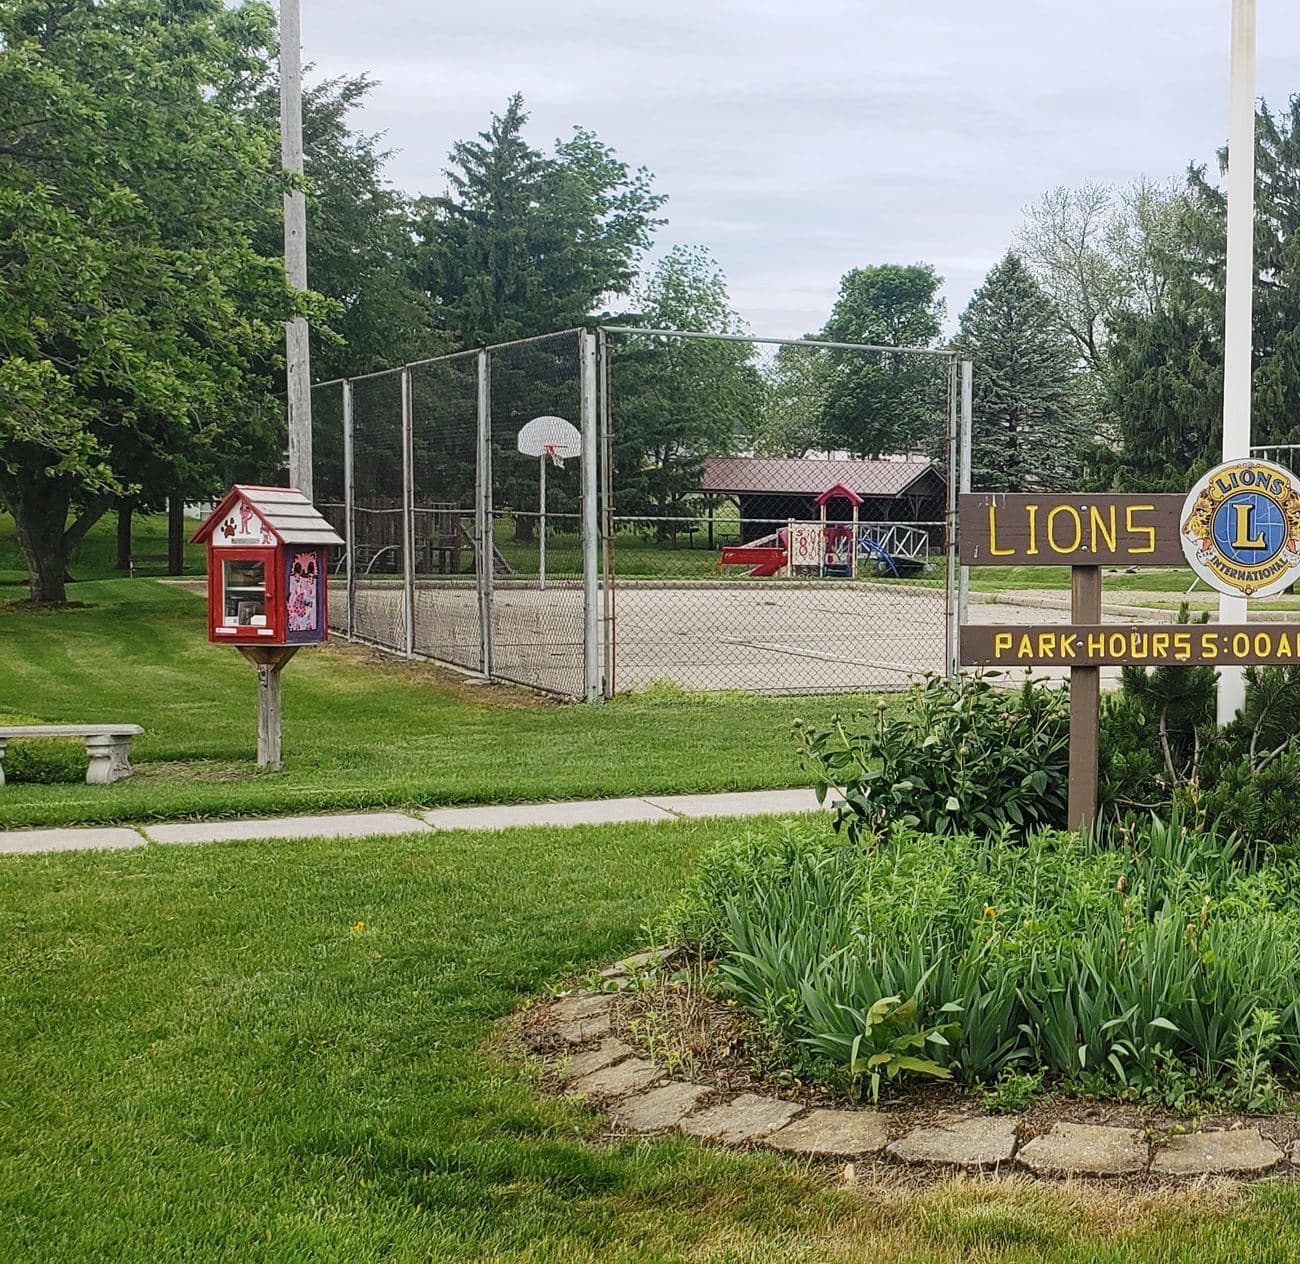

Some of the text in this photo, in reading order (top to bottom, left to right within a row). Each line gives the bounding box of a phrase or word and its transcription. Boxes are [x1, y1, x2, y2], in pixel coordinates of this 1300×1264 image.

[1215, 469, 1285, 496] LIONS
[989, 504, 1156, 556] LIONS
[1231, 504, 1268, 550] L
[1210, 556, 1289, 581] INTERNATIONAL
[994, 632, 1077, 659] PARK
[1087, 632, 1192, 660] HOURS
